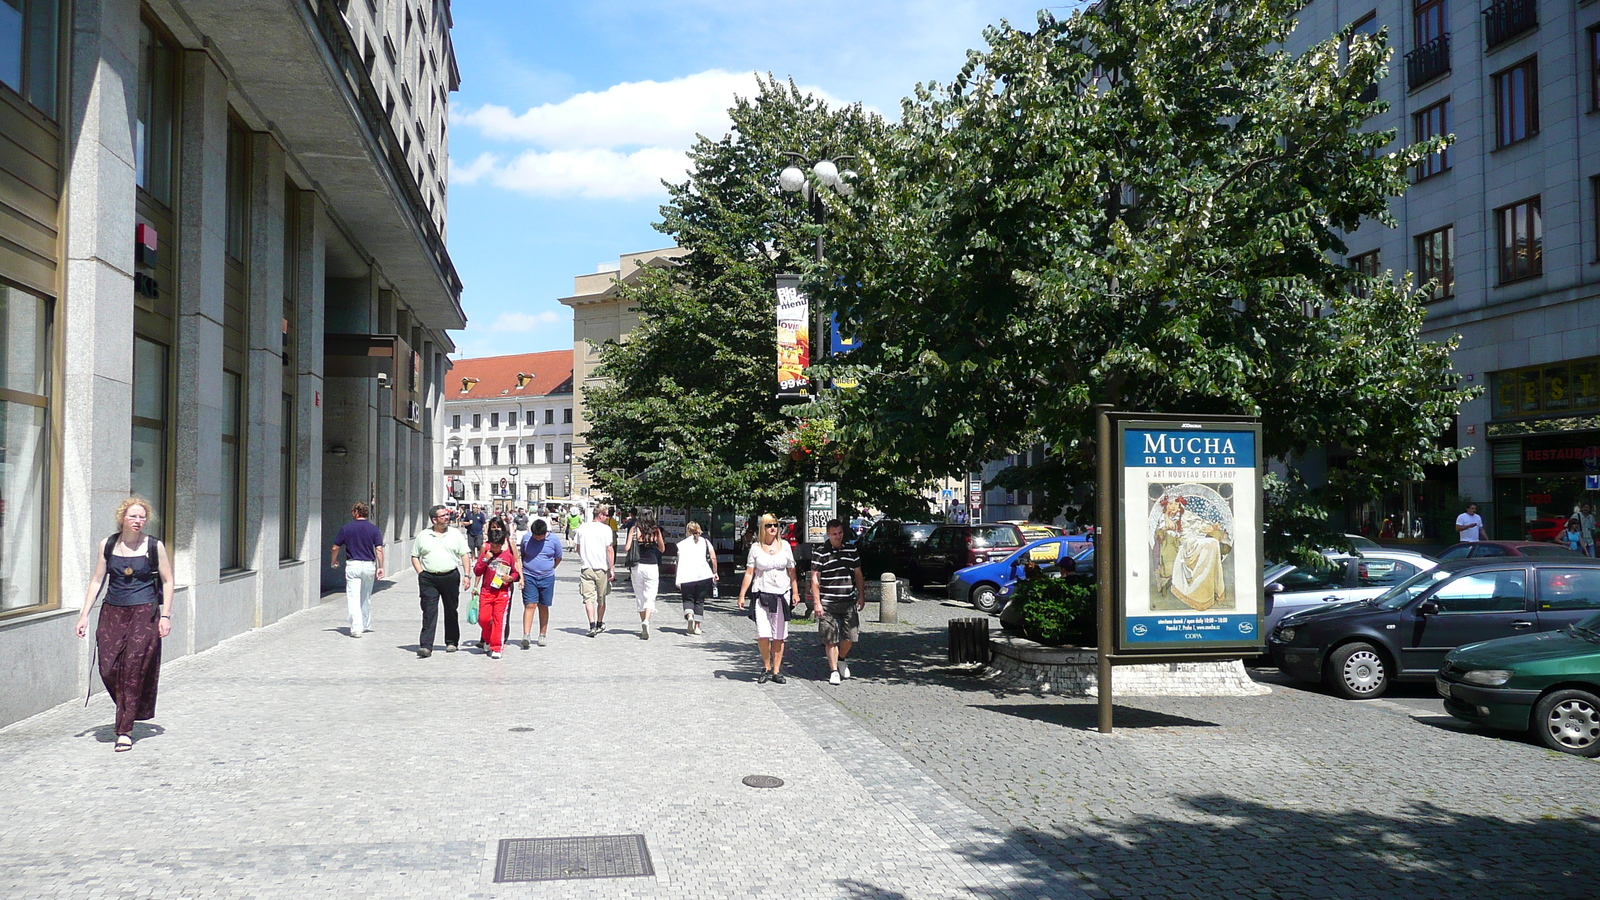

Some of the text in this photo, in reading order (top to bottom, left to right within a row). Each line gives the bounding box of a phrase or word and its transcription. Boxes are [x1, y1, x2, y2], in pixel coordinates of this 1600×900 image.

[138, 274, 160, 299] KB
[777, 286, 797, 297] Big
[781, 298, 807, 309] menu
[780, 379, 795, 390] 99
[1143, 433, 1236, 454] MUCHA
[1145, 456, 1236, 465] museum
[1202, 470, 1216, 478] GIFT
[1219, 470, 1236, 478] SHOP
